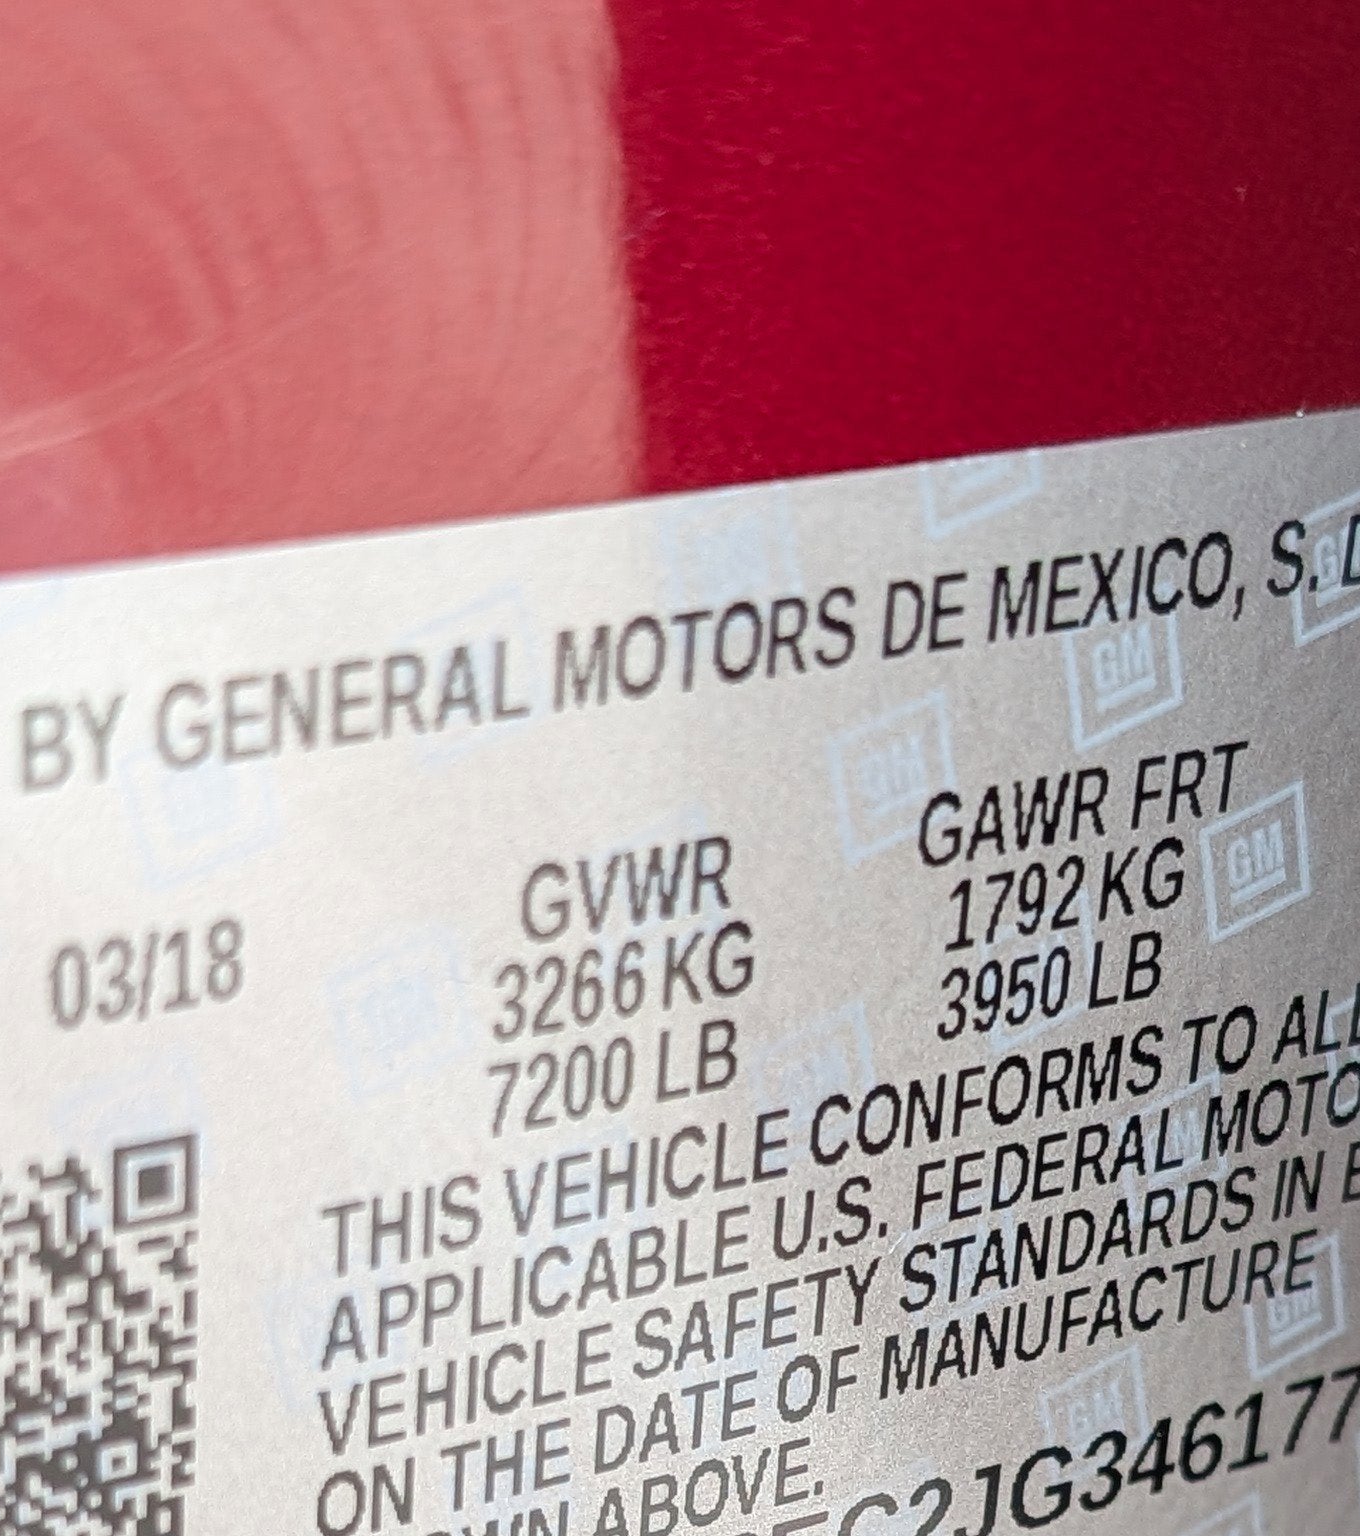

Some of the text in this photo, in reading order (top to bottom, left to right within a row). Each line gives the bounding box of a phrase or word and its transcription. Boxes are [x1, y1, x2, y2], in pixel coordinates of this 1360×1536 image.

[20, 695, 125, 792] BY
[157, 643, 530, 771] GENERAL
[554, 586, 857, 713] MOTORS
[882, 572, 968, 660] DE
[989, 532, 1246, 643] MEXICO,
[1266, 519, 1318, 597] S.
[918, 767, 1111, 868] GAWR
[1131, 740, 1249, 830] FRT
[1228, 820, 1285, 890] GM
[521, 834, 733, 945] GVWR
[945, 836, 1186, 952] 1792 KG
[49, 917, 244, 1030] 03/18
[491, 921, 756, 1044] 3266 KG
[937, 930, 1165, 1042] 3950 LB
[488, 1017, 740, 1137] 7200 LB
[322, 1175, 482, 1277] THIS
[504, 1107, 790, 1237] VEHICLE
[810, 1024, 1163, 1167] CONFORMS
[1184, 1005, 1258, 1083] TO
[320, 1323, 614, 1457] VEHICLE
[632, 1257, 881, 1382] SAFETY
[898, 1164, 1258, 1315] STANDARDS
[1272, 1150, 1324, 1221] IN
[321, 1205, 752, 1372] APPLICABLE
[772, 1175, 889, 1263] U.S.
[911, 1126, 1184, 1230] FEDERAL
[443, 1417, 572, 1513] THE
[594, 1370, 759, 1475] DATE
[777, 1345, 860, 1422] OF
[879, 1229, 1318, 1400] MANUFACTURE
